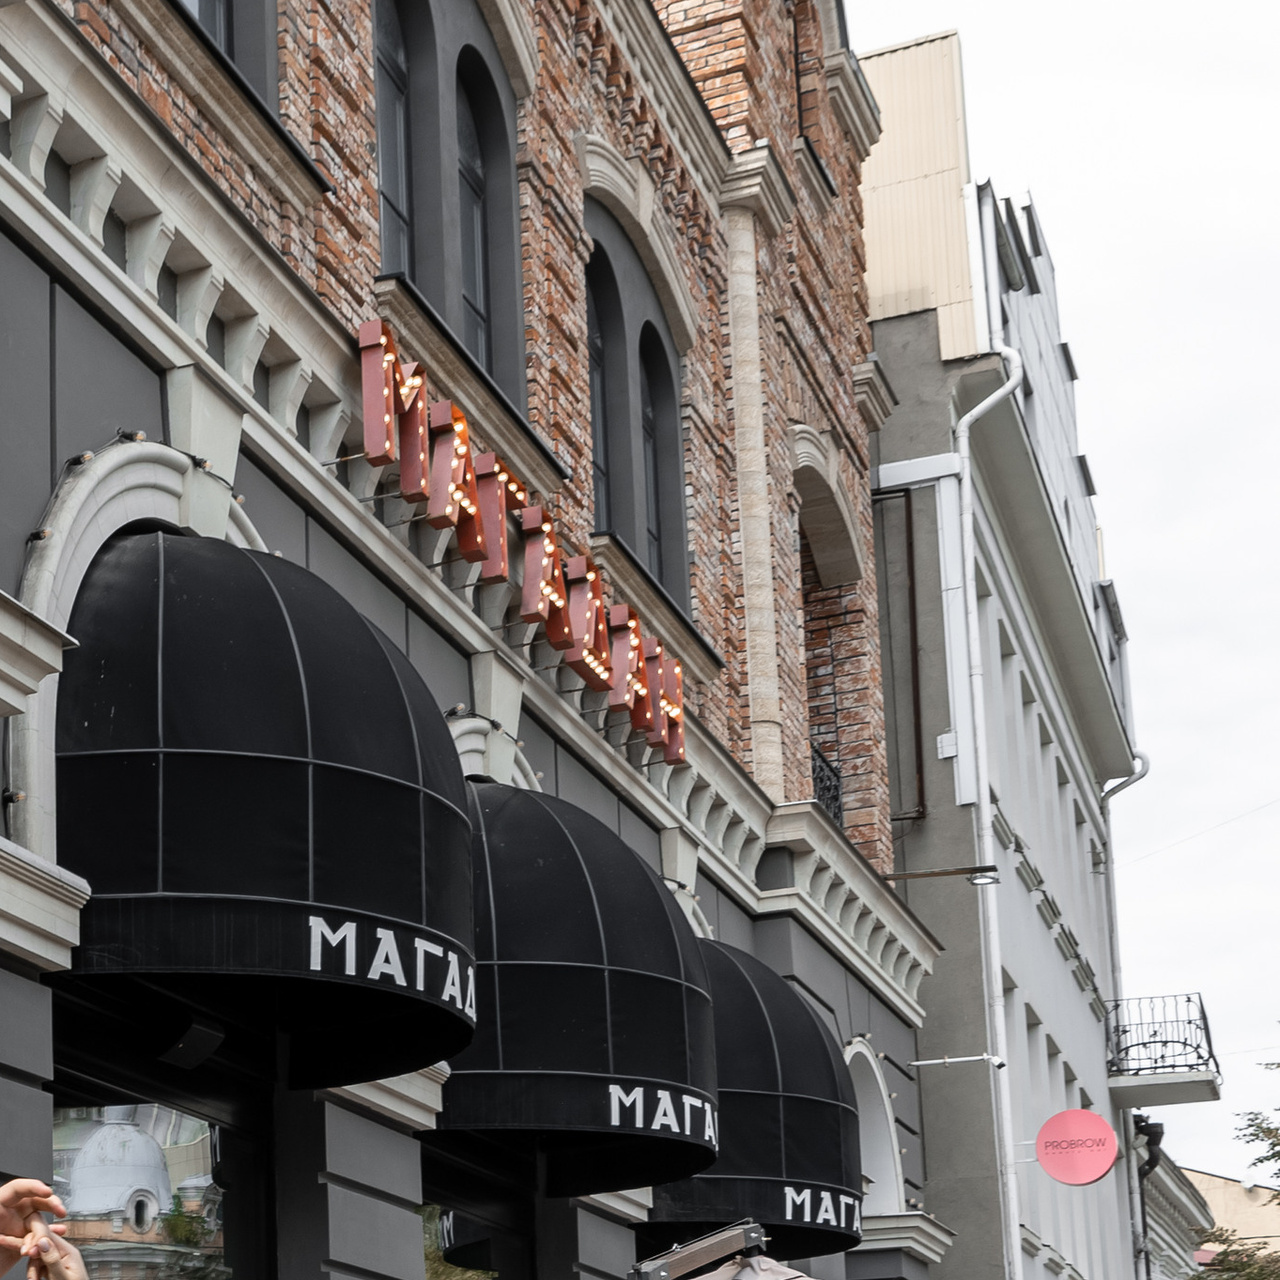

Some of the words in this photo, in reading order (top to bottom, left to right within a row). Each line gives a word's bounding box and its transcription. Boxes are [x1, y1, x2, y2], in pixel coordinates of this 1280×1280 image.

[358, 318, 686, 766] МАГАДАН
[1044, 1137, 1107, 1150] PROBROW
[783, 1186, 863, 1237] МАГА
